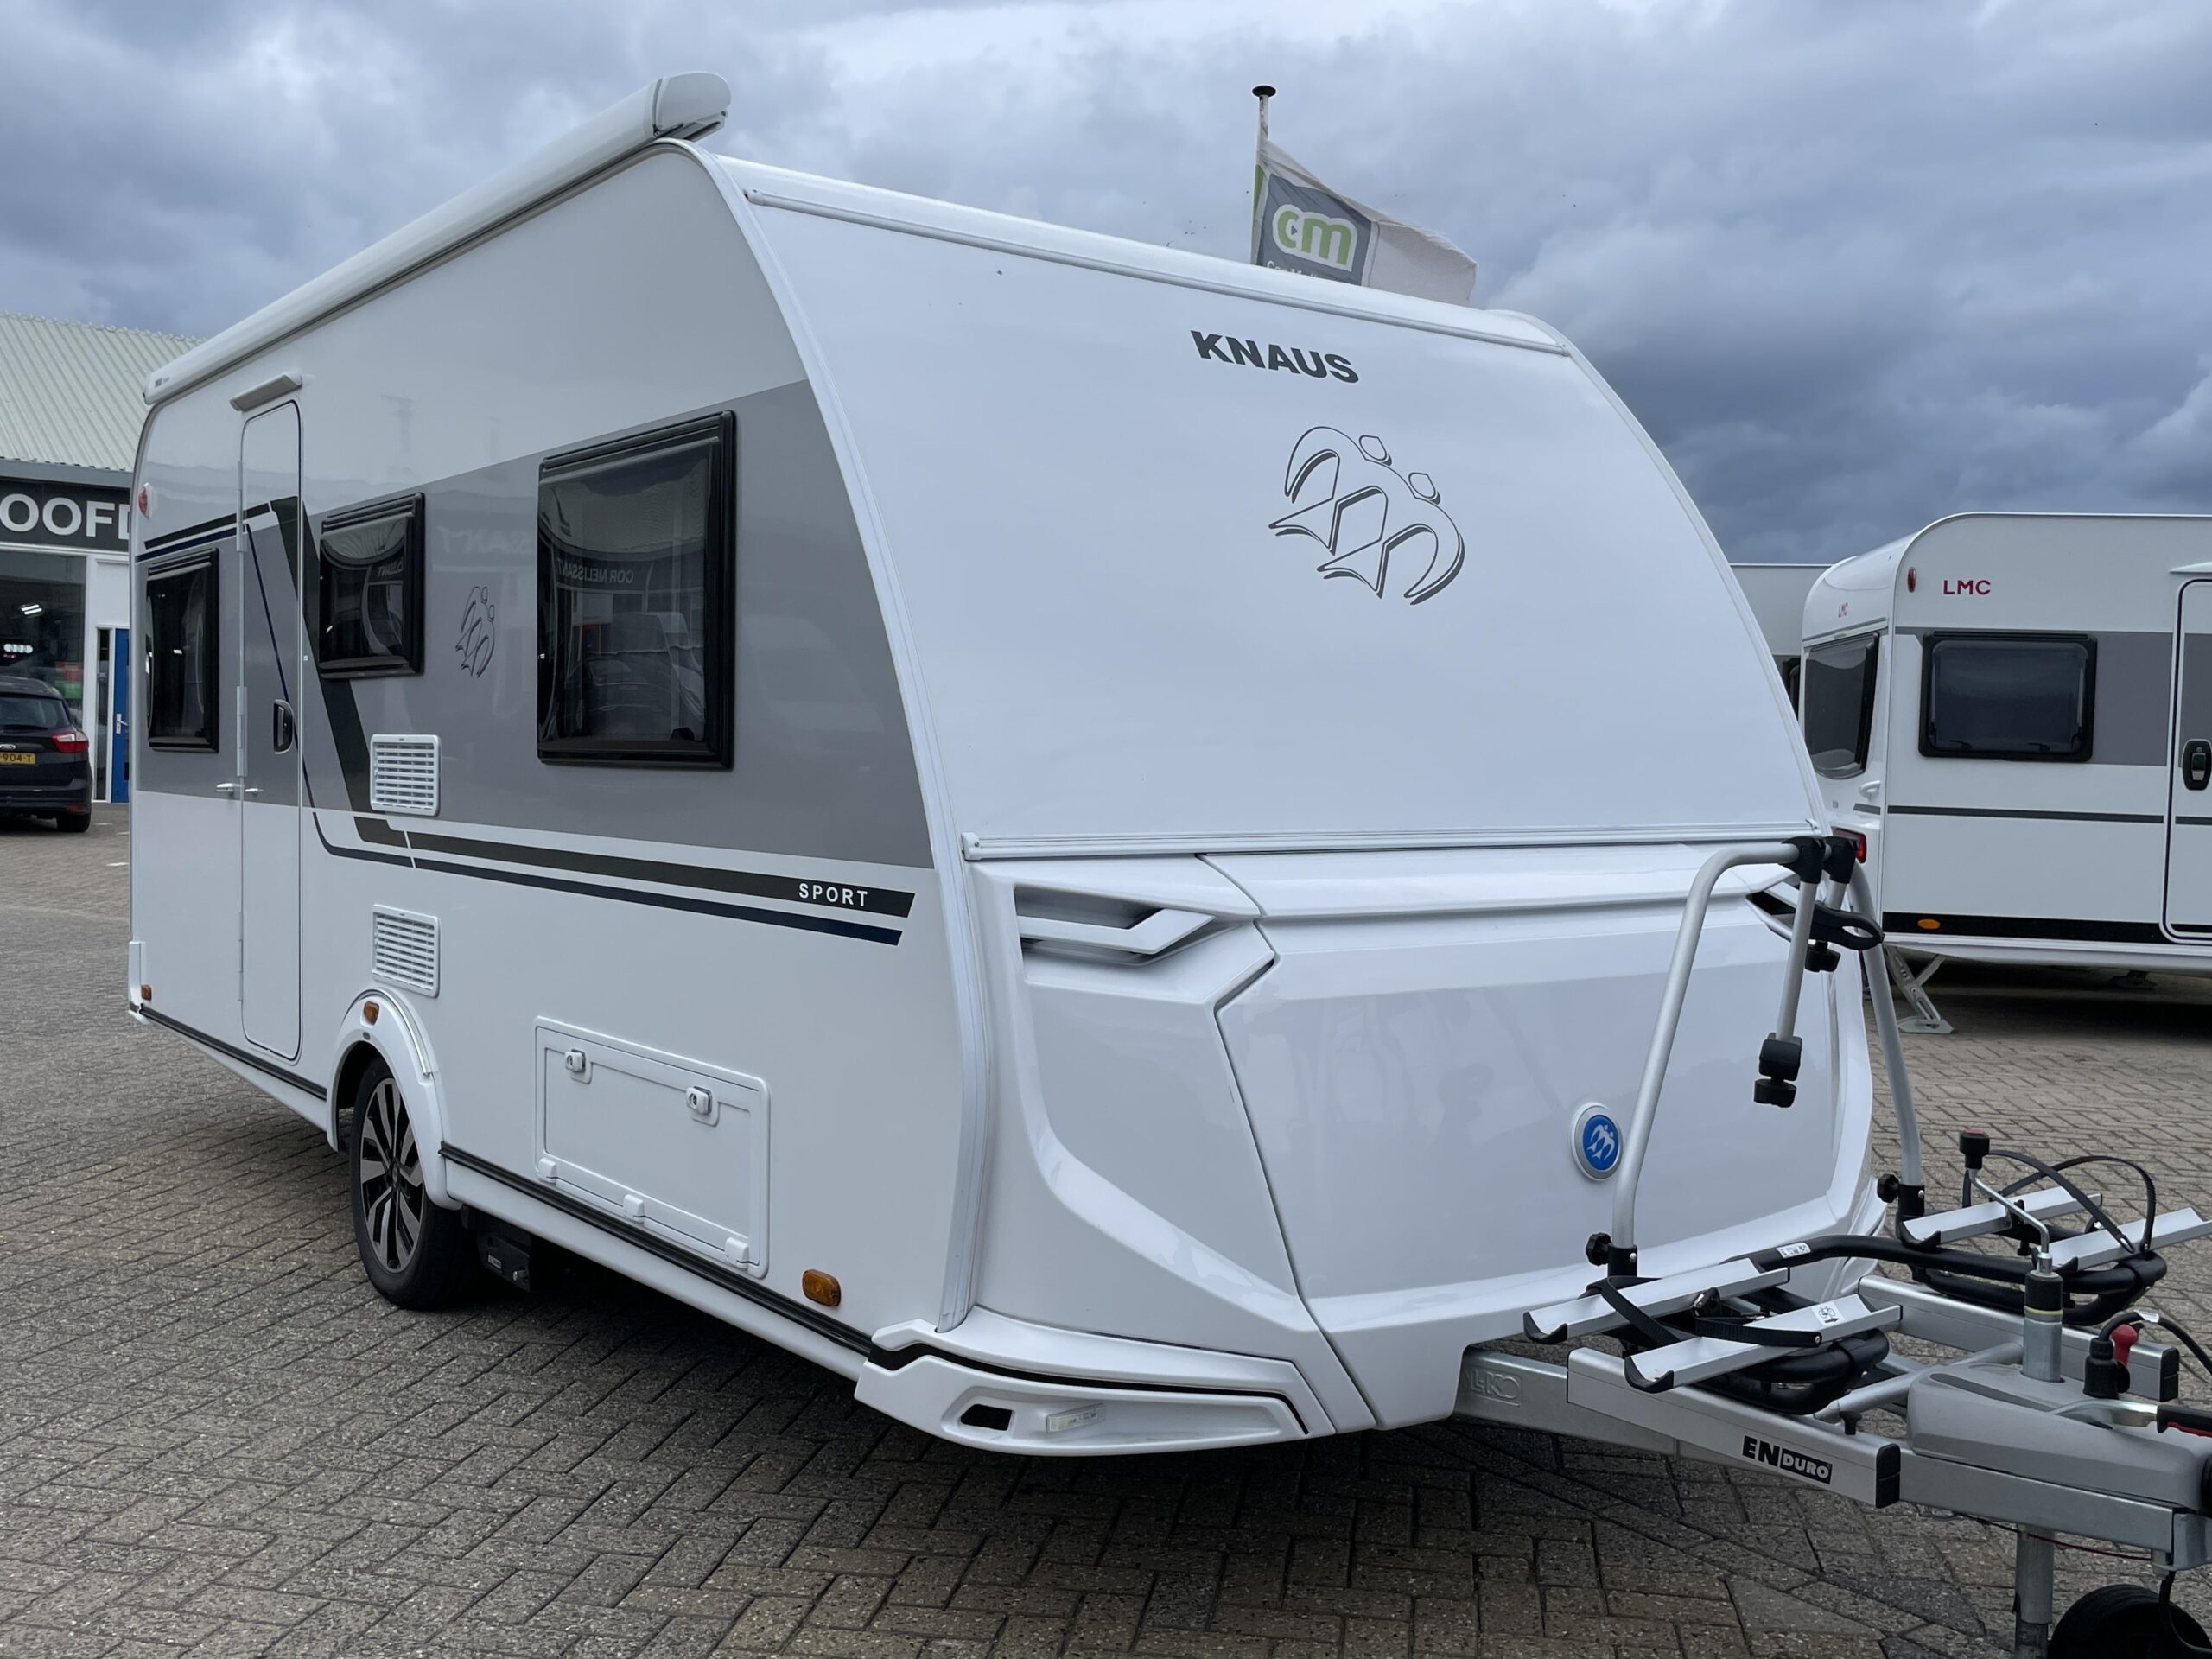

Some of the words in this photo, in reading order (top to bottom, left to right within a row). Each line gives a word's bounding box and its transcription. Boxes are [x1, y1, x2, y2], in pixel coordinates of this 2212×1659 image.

[1277, 210, 1352, 265] cm
[1190, 330, 1359, 383] KNAUS
[1943, 580, 1991, 595] LMC
[798, 883, 868, 906] SPORT
[1742, 1435, 1831, 1481] ENDURO
